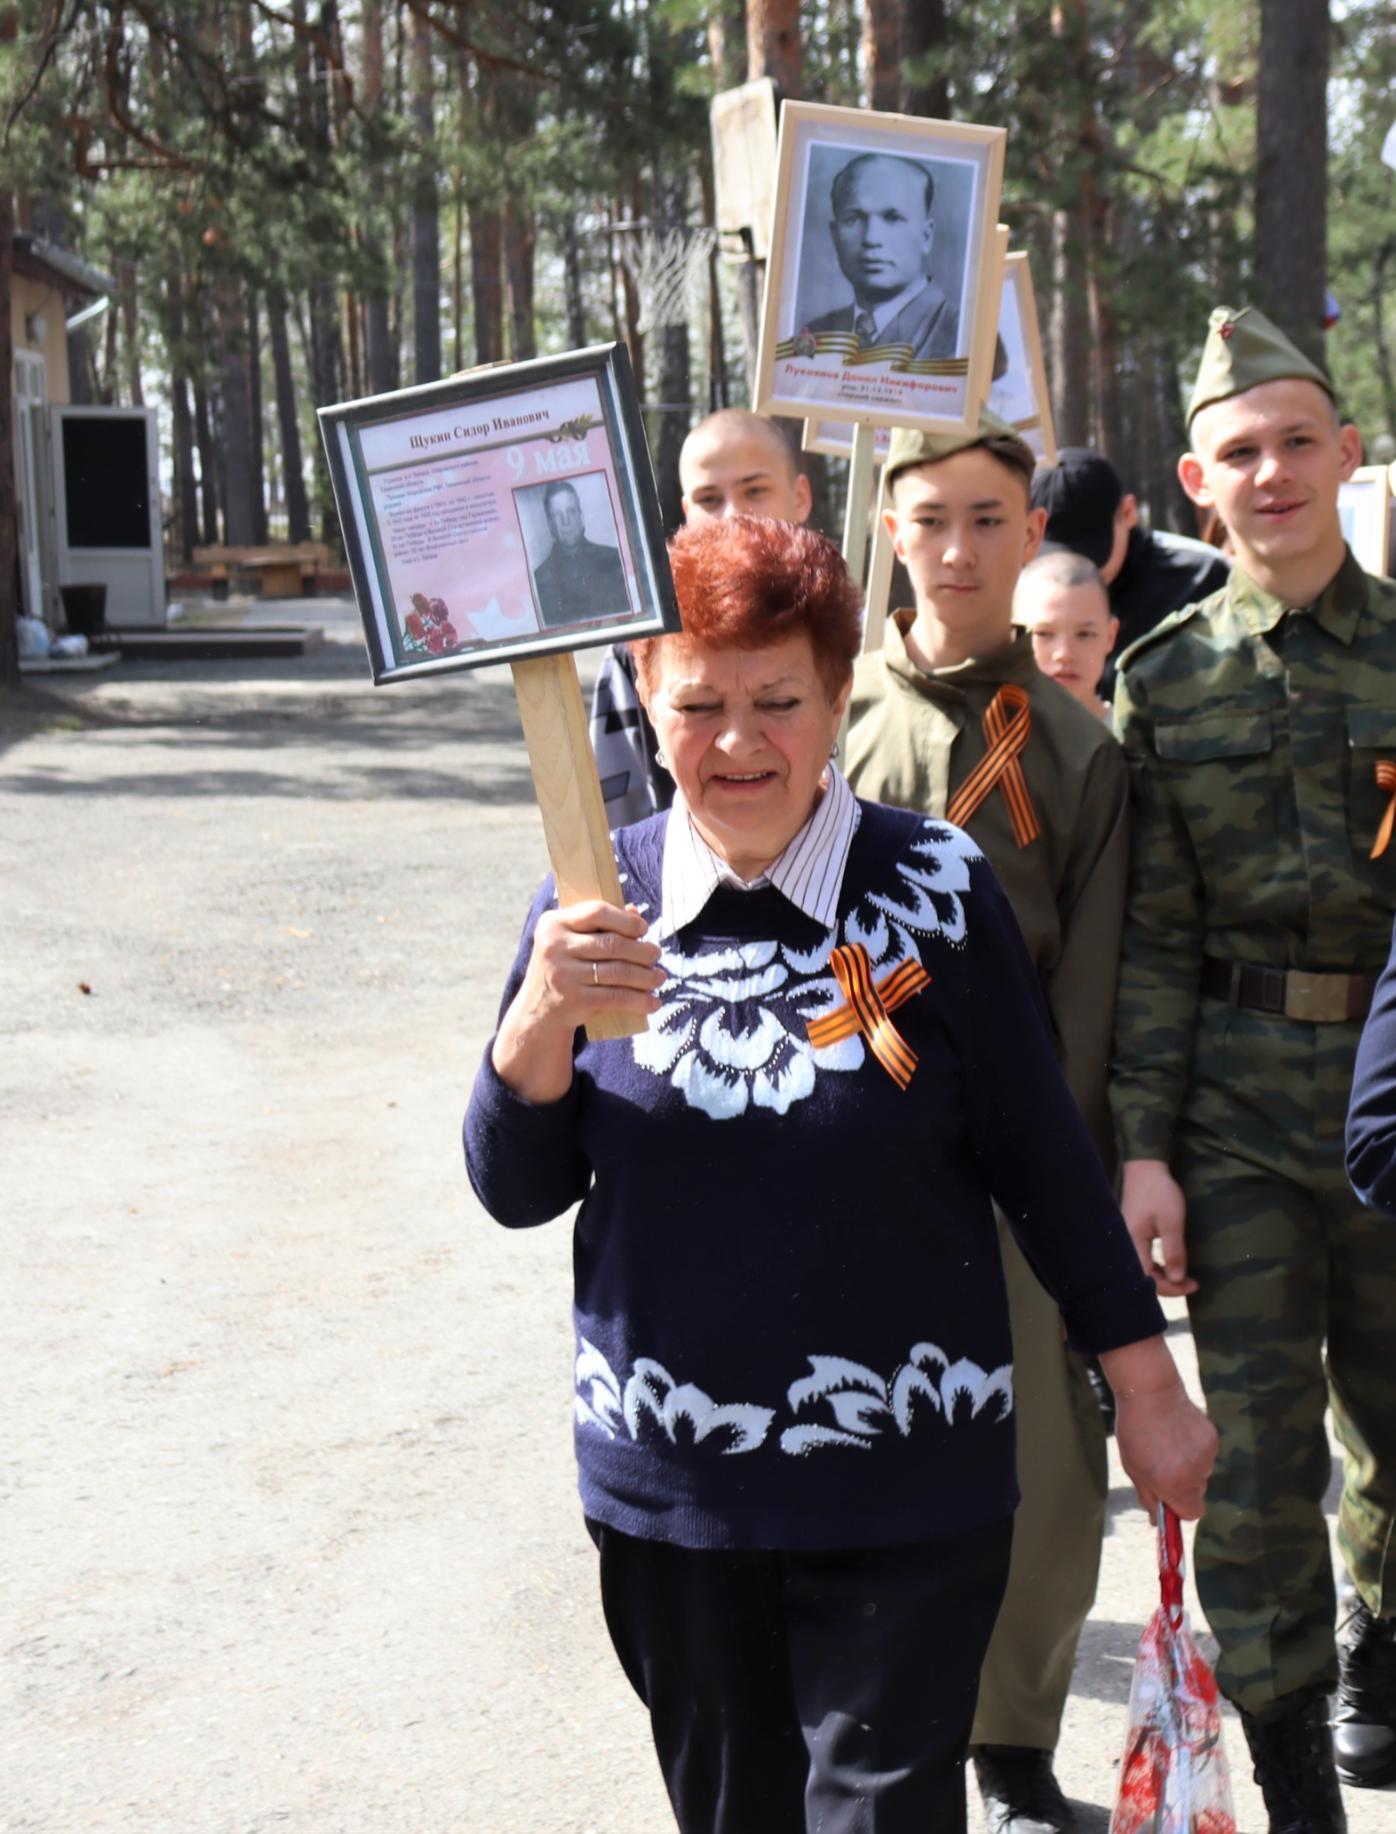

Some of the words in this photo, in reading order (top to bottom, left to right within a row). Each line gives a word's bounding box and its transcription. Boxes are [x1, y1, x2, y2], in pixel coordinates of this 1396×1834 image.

[410, 430, 451, 449] Щукин
[453, 422, 490, 439] Сидор
[492, 409, 550, 431] Иванович
[506, 446, 526, 482] 9
[534, 443, 591, 476] мая
